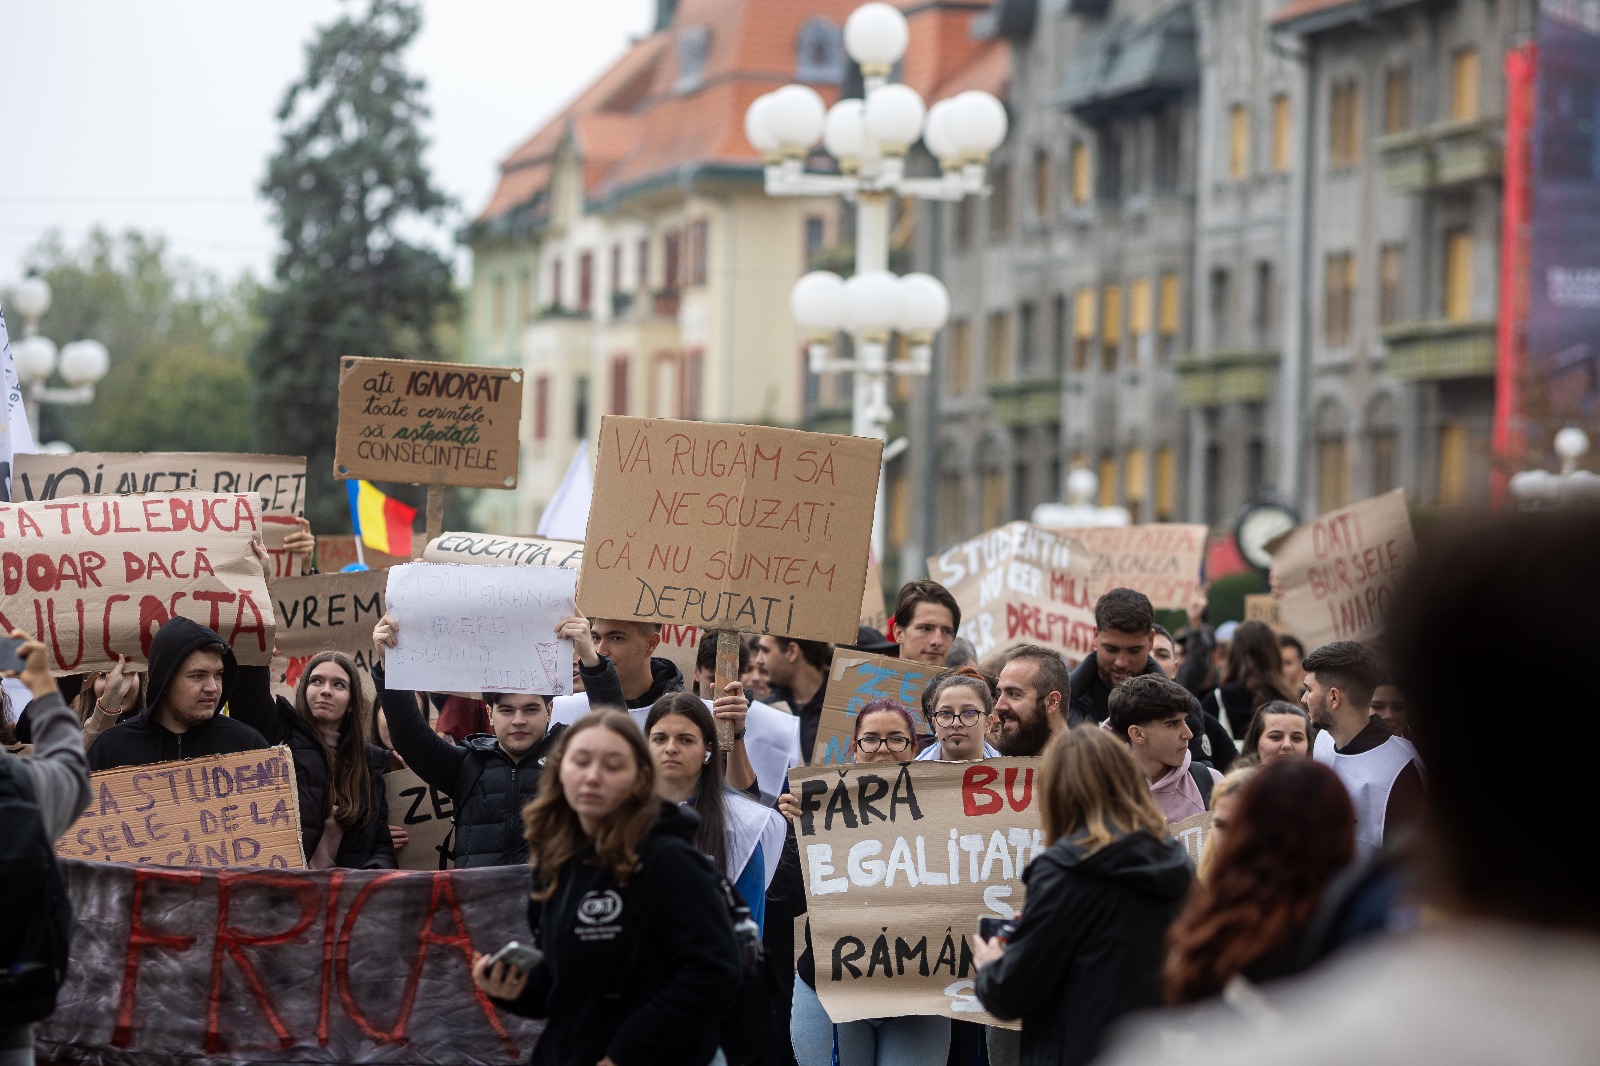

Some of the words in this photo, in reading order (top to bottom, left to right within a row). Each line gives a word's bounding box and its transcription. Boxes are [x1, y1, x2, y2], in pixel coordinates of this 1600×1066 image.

[405, 370, 510, 402] IGNORAT
[362, 394, 408, 417] toate
[357, 440, 498, 471] CONSECINȚELE
[615, 421, 651, 474] VĂ
[665, 431, 783, 481] RUGĂM
[793, 439, 838, 486] SĂ
[648, 489, 701, 526] NE
[2, 550, 107, 596] DOAR
[123, 547, 215, 583] DACĂ
[595, 531, 637, 571] CĂ
[647, 543, 692, 573] NU
[704, 550, 836, 592] SUNTEM
[278, 592, 382, 629] VREM
[1006, 602, 1097, 653] DREPTAT
[250, 799, 290, 828] LA
[801, 761, 925, 837] FĂRĂ
[962, 765, 1034, 817] BU
